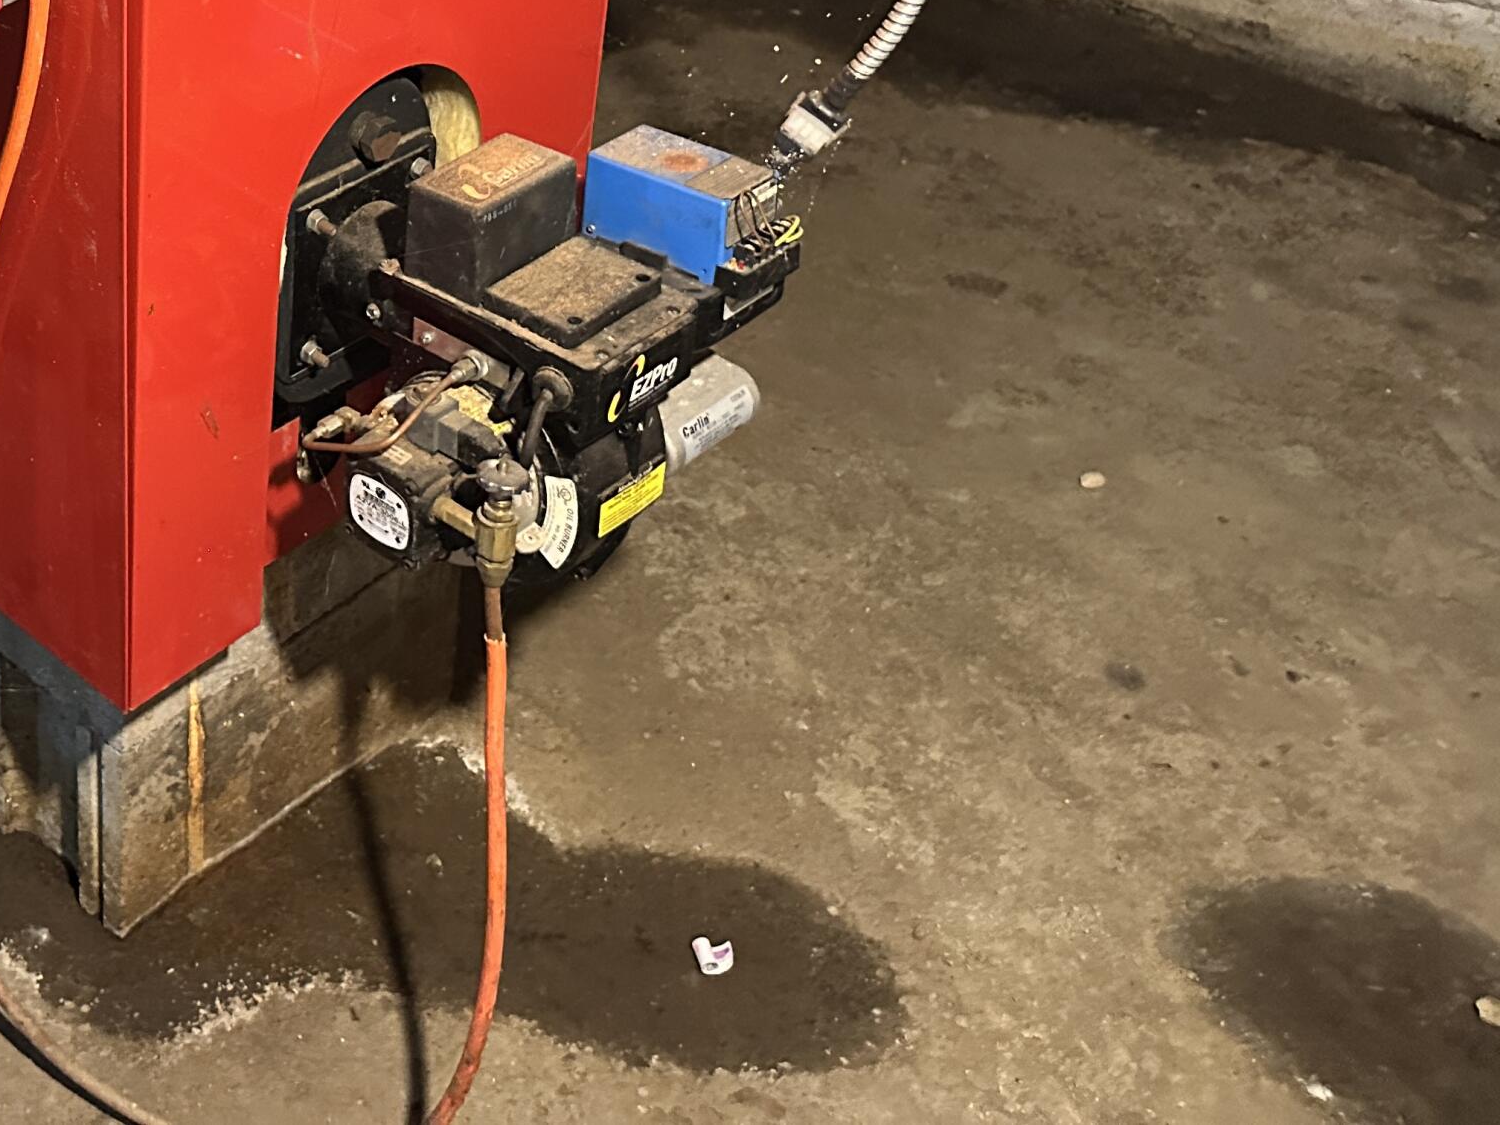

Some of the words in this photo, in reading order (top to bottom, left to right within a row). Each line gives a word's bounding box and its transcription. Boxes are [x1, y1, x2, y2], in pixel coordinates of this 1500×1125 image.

[629, 356, 678, 402] EZPro
[682, 415, 710, 439] Carlin
[566, 508, 574, 521] OIL
[556, 523, 573, 553] BURNER
